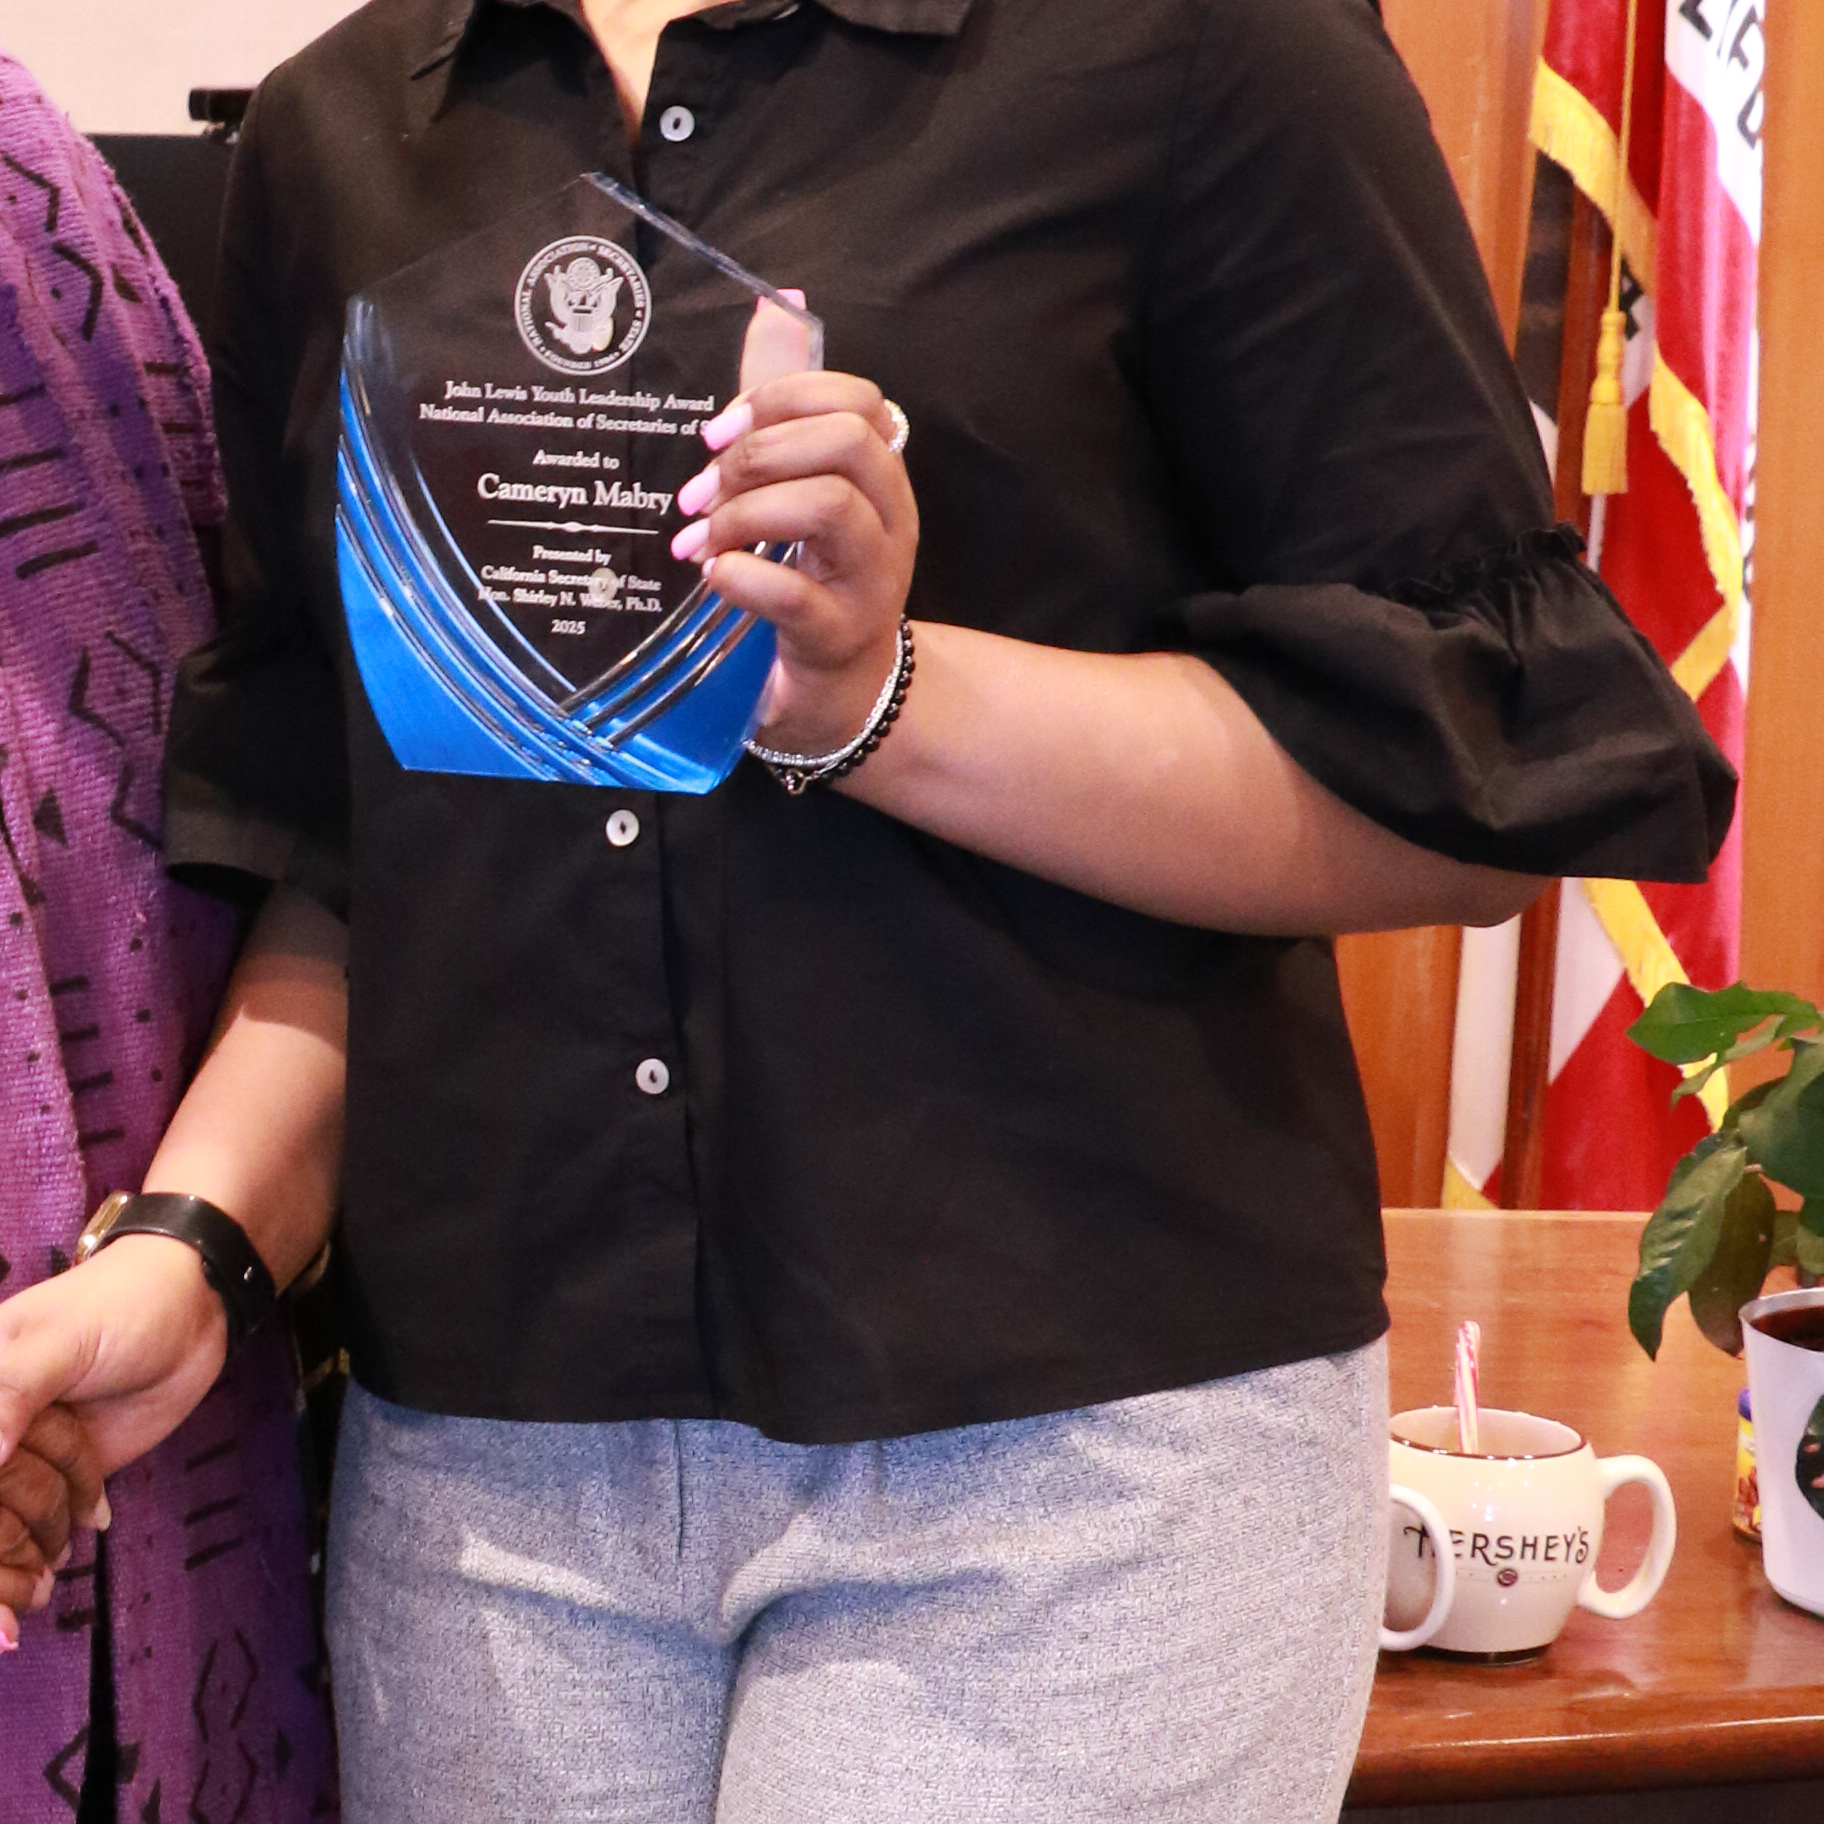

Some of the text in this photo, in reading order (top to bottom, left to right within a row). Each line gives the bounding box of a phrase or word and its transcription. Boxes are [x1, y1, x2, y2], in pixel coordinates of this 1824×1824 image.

[445, 380, 715, 411] John Lewis Youth Leadership Award
[419, 404, 484, 423] National
[487, 408, 574, 428] Association
[576, 413, 595, 430] of
[596, 414, 677, 435] Secretaries
[680, 420, 700, 436] of
[532, 449, 620, 469] Awarded to
[477, 473, 673, 515] Cameryn Mabry
[532, 545, 612, 566] Presented by
[481, 565, 546, 583] California
[628, 575, 661, 591] State
[513, 588, 557, 607] Shirley
[560, 591, 576, 606] N.
[626, 597, 662, 612] Ph.D.
[551, 619, 586, 635] 2025
